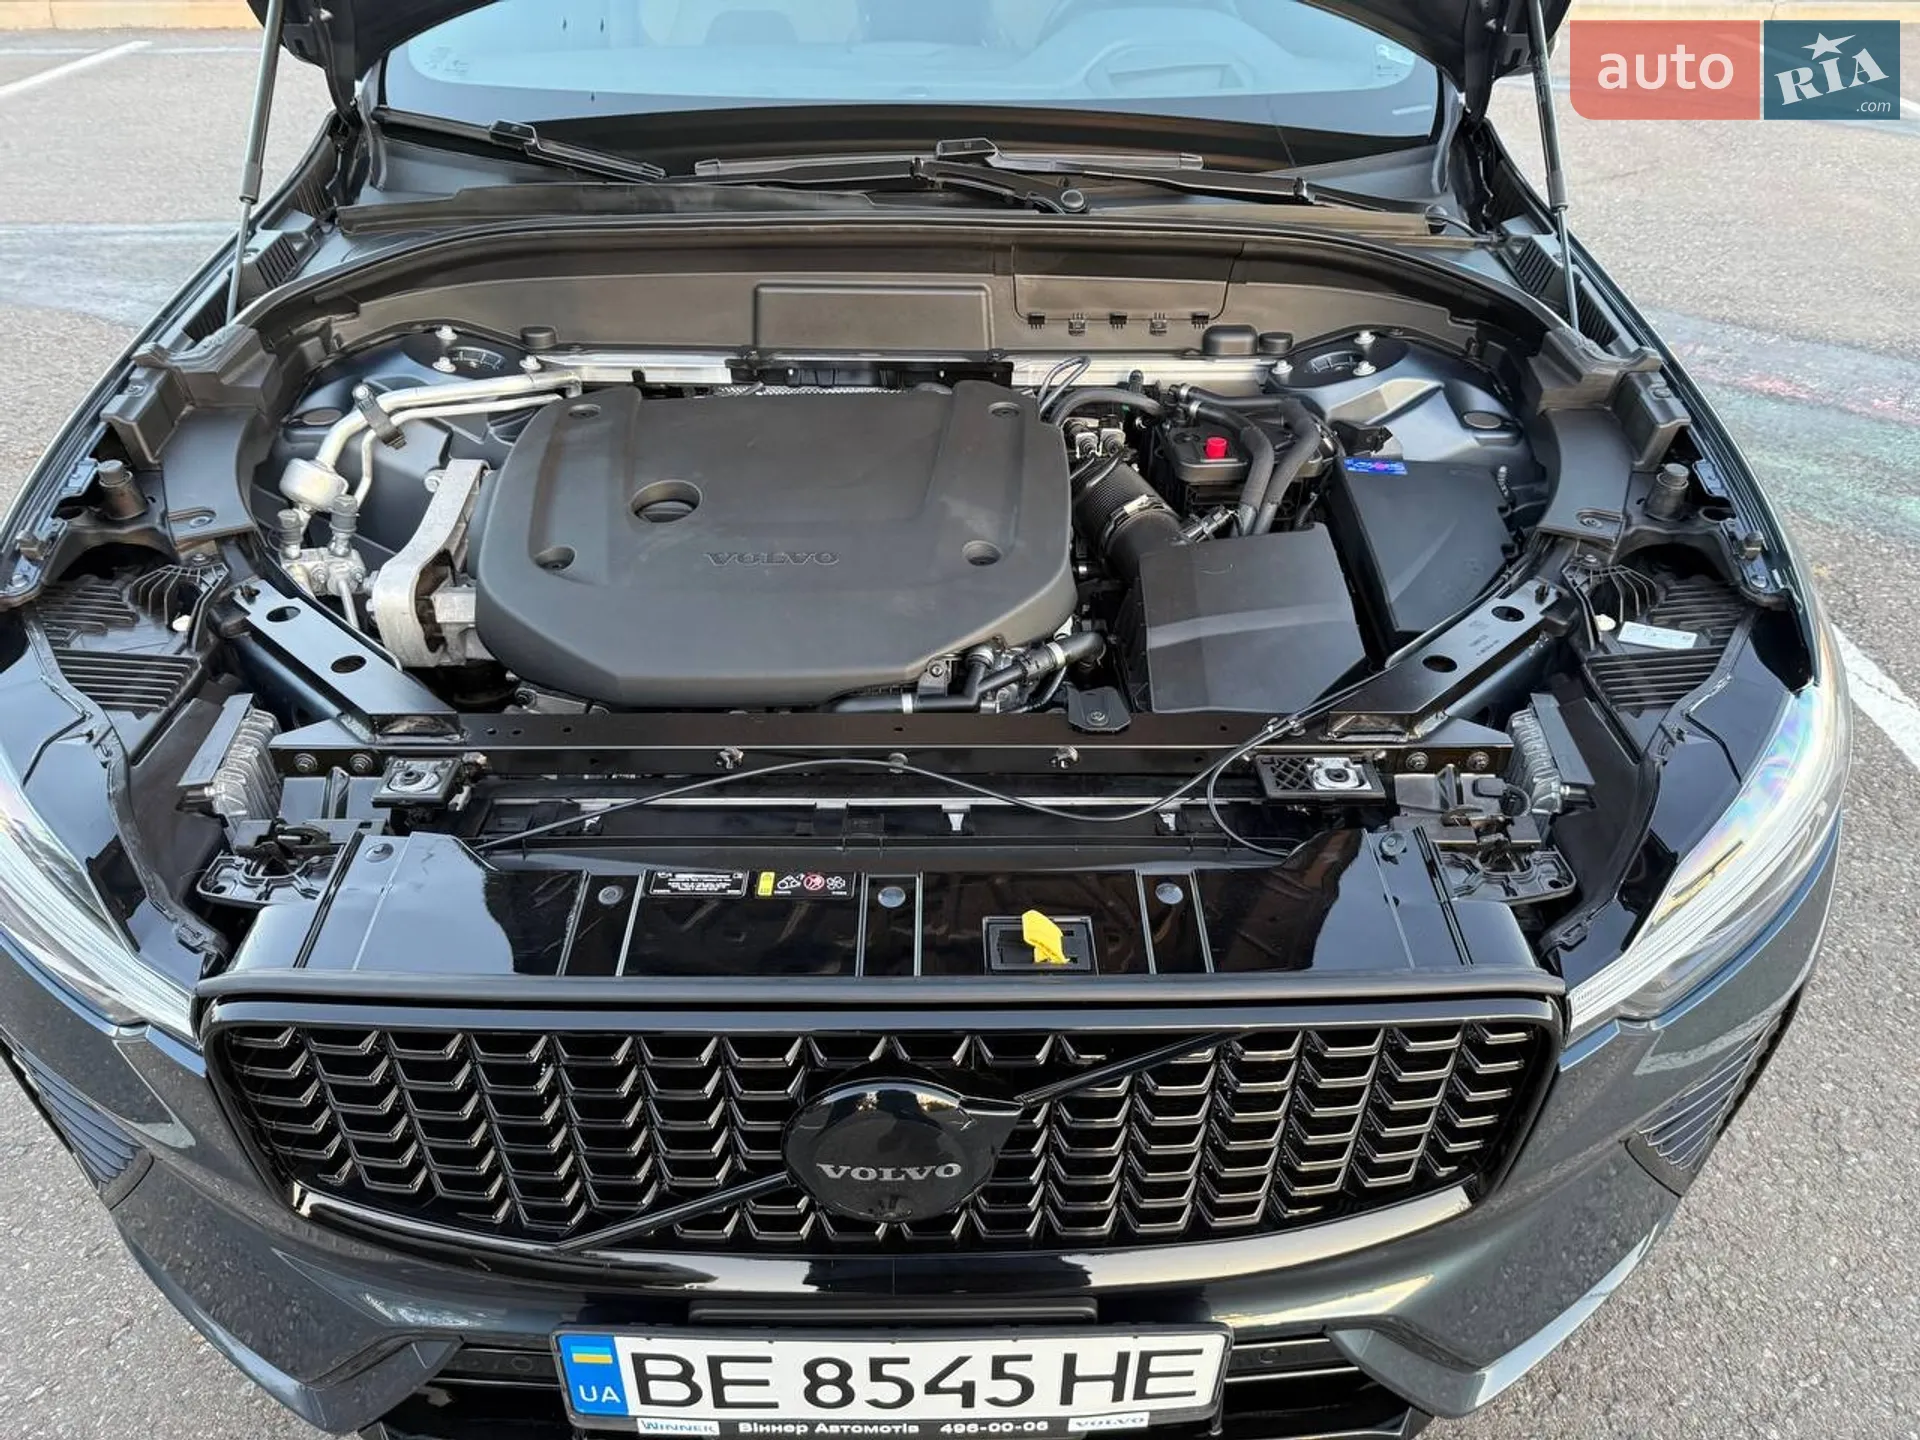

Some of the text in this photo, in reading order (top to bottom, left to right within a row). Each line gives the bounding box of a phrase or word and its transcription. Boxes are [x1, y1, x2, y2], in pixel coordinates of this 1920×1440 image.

[703, 551, 840, 567] VOLVO
[815, 1162, 962, 1181] VOLVO
[630, 1347, 1204, 1410] BE 8545 HE
[579, 1385, 622, 1404] UA
[814, 1422, 920, 1434] Автомотів
[1075, 1416, 1145, 1427] VOLVO
